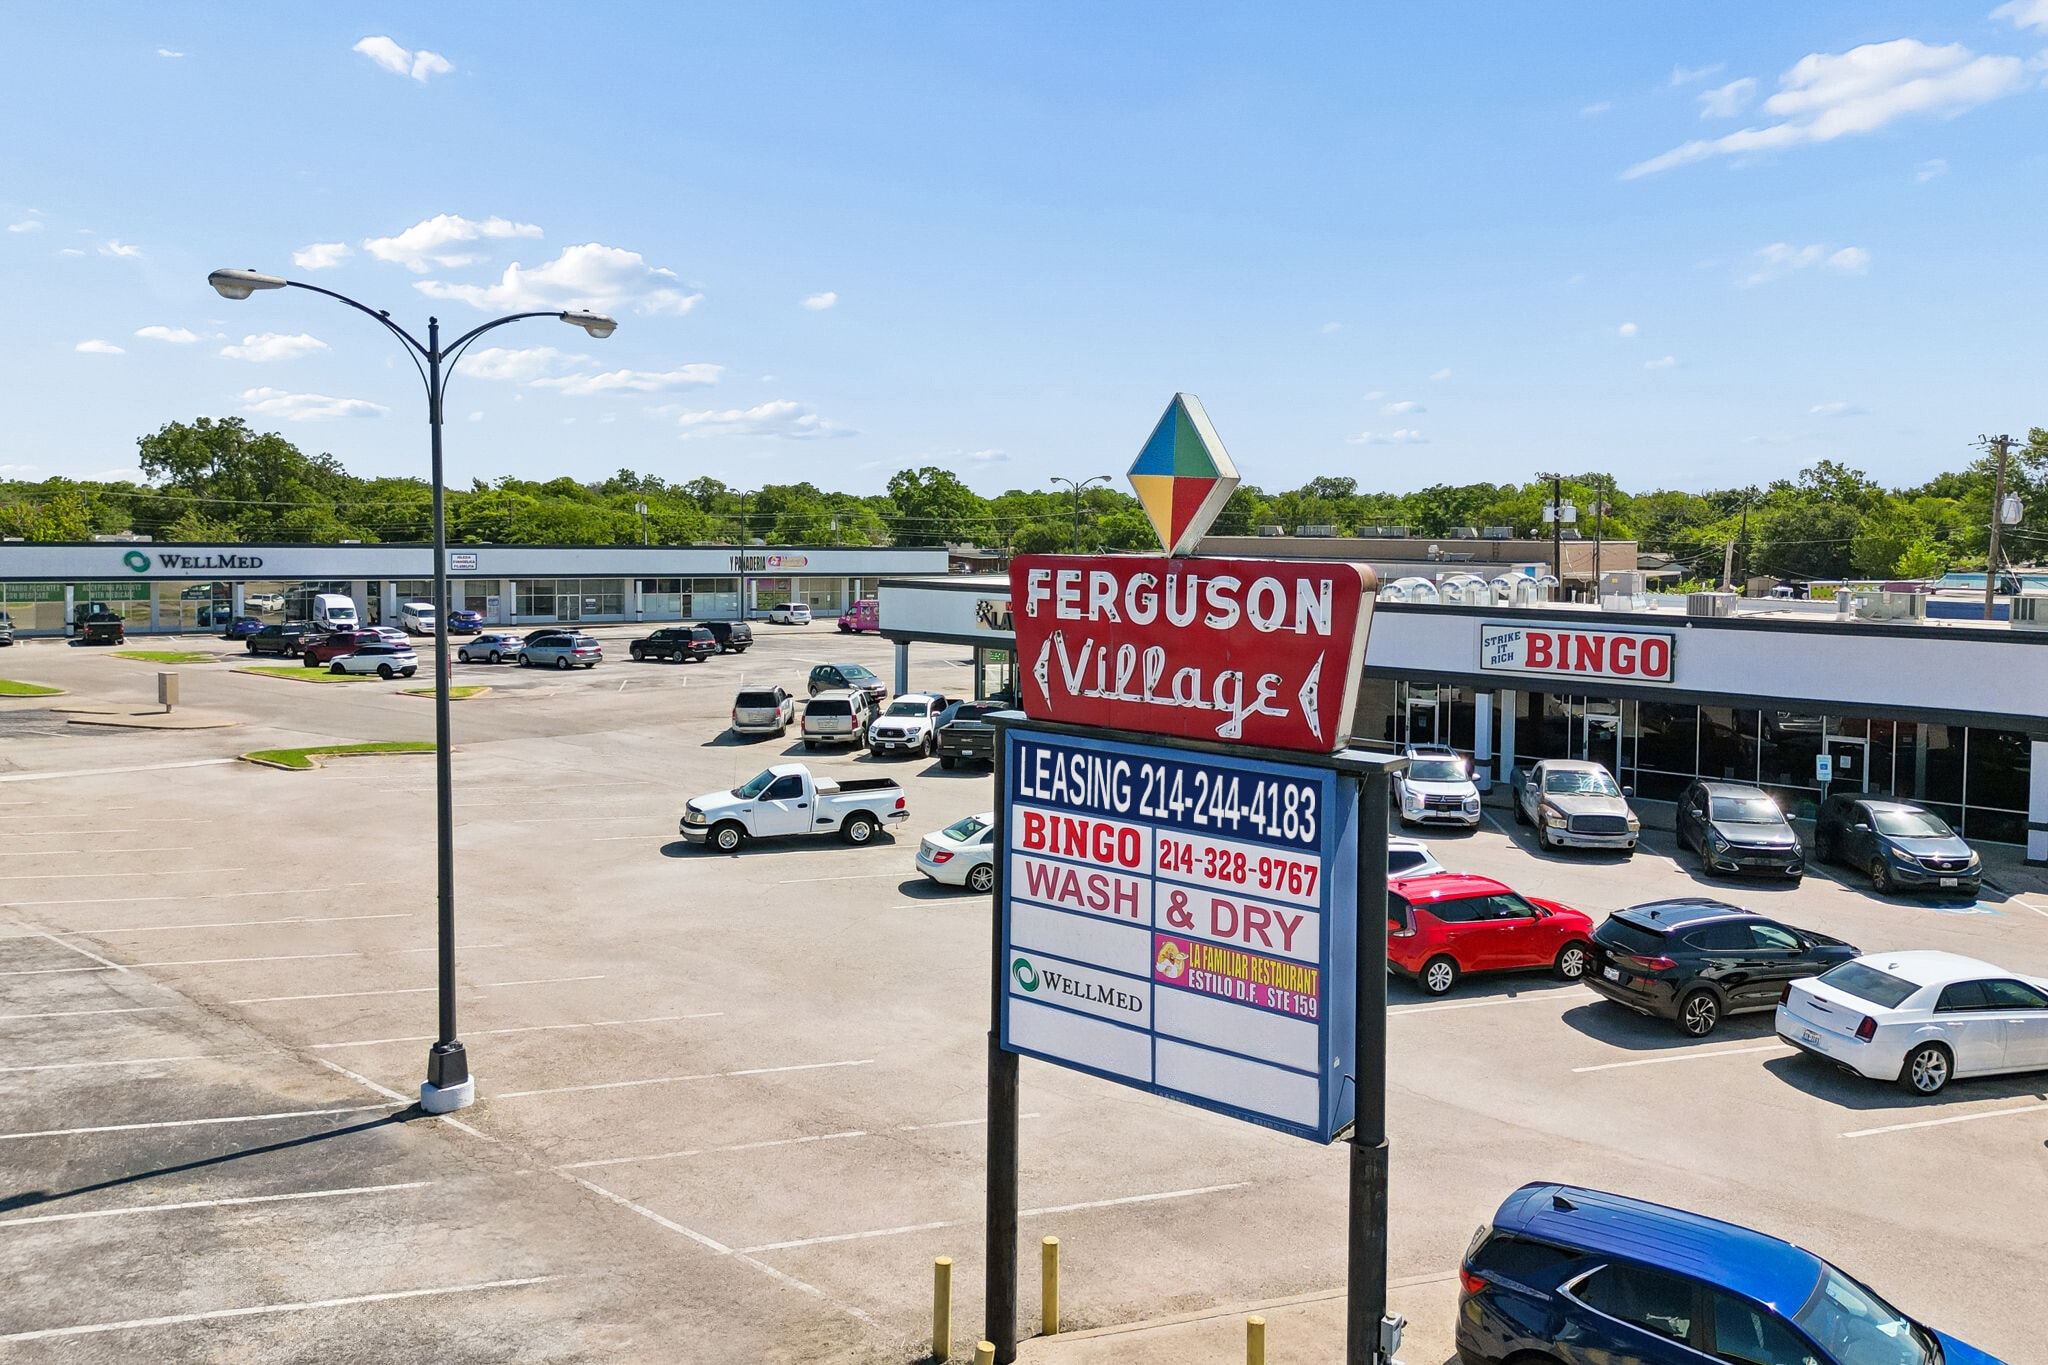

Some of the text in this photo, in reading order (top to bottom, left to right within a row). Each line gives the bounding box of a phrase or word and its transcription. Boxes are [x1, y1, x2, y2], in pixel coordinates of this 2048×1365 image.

[1027, 568, 1333, 636] FERGUSON
[1484, 631, 1521, 647] STRIKE
[1491, 652, 1514, 665] RICH
[1497, 644, 1507, 653] IT
[1525, 632, 1669, 677] BINGO
[1054, 630, 1289, 739] Village
[1020, 746, 1317, 843] LEASING 214-244-4183
[1023, 811, 1318, 897] BINGO 214-328-9767
[1025, 861, 1304, 952] WASH & DRY
[1188, 968, 1318, 1018] ESTILO D.F. STE 159
[1189, 942, 1318, 996] LA FAMILIAR RESTAURANT
